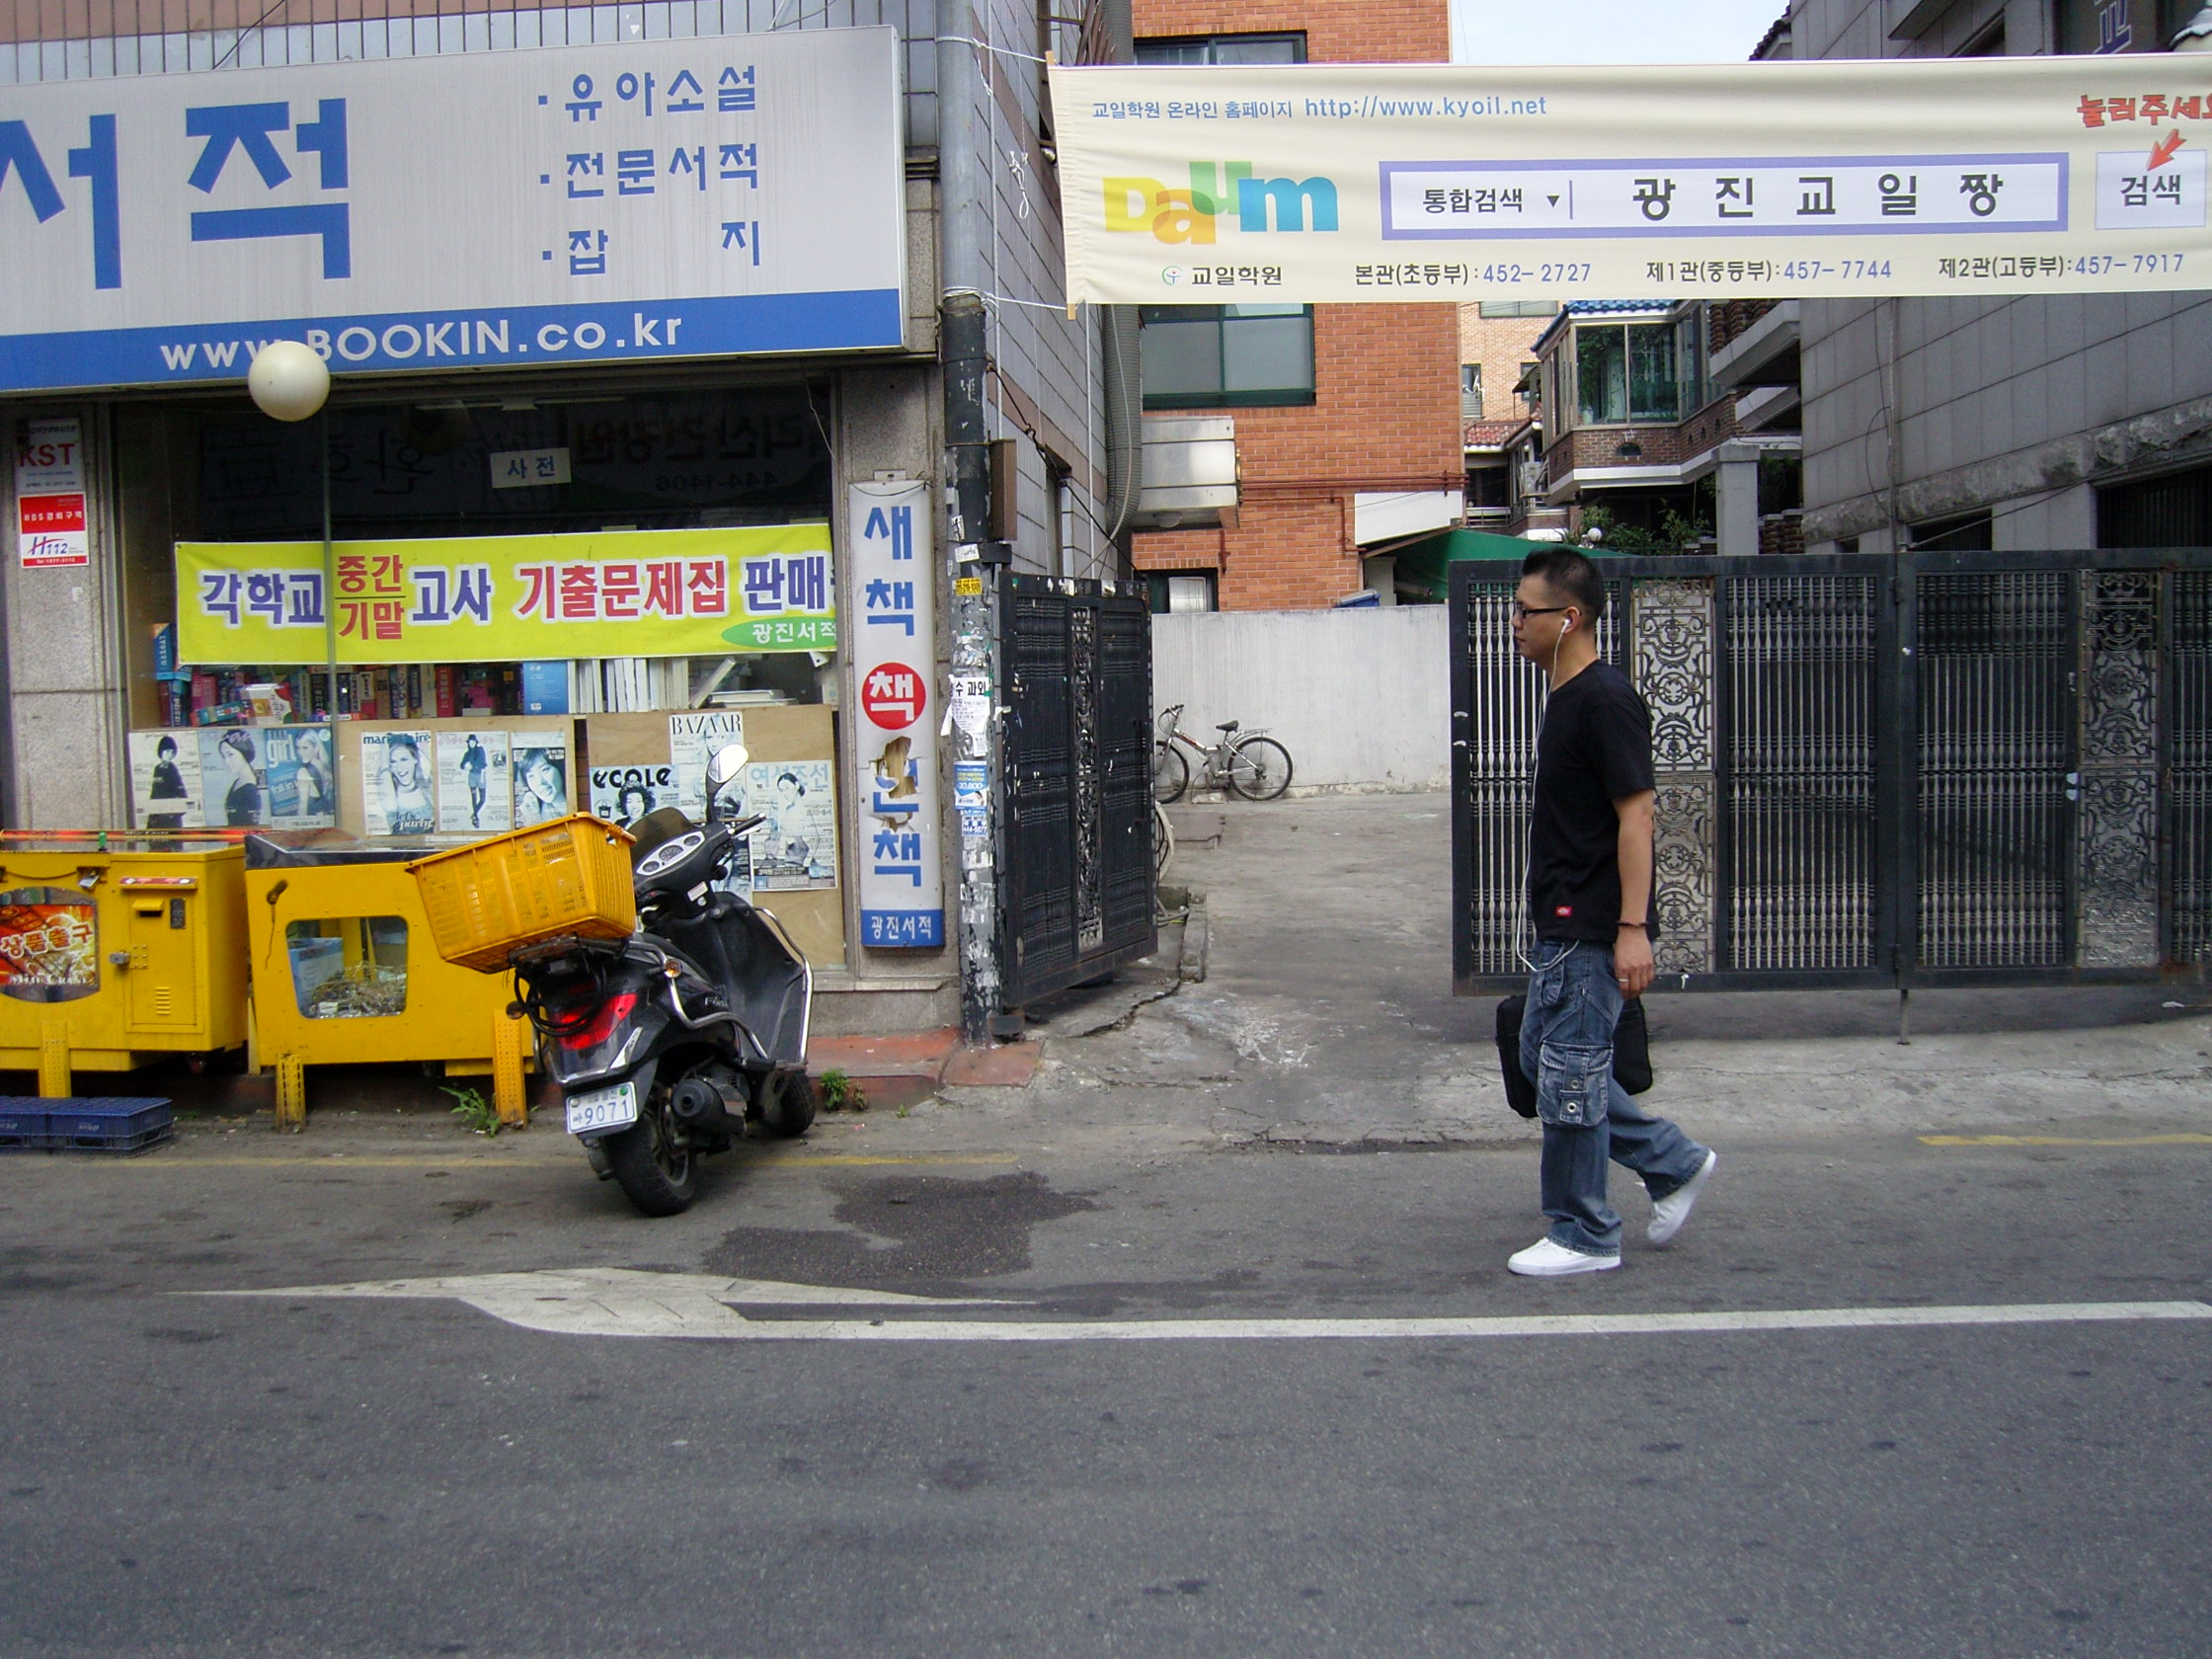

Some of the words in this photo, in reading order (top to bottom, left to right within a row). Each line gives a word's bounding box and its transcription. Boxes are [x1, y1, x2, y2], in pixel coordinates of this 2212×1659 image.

[565, 65, 755, 121] 유아소설
[1092, 102, 1160, 118] 교일학원
[1167, 101, 1218, 118] 온라인
[1224, 101, 1293, 118] 홈페이지
[1304, 96, 1547, 118] http://www.kyoil.net
[566, 143, 757, 198] 전문서적
[1103, 161, 1339, 244] Daum
[1422, 188, 1523, 213] 통합검색
[2120, 174, 2181, 206] 검색
[1191, 266, 1282, 285] 교일학원
[160, 313, 681, 370] wwBOOKIN.co.kr
[20, 442, 76, 467] KST
[203, 574, 325, 624] 각학교
[337, 555, 403, 592] 중간
[413, 568, 492, 621] 고사
[518, 560, 725, 619] 기출문제집
[745, 556, 835, 610] 판매
[339, 601, 404, 640] 기말
[752, 622, 836, 643] 광진서적
[869, 672, 914, 721] 책
[672, 714, 742, 736] BAZAAR
[1, 922, 94, 958] 상품출구
[871, 915, 931, 940] 광진서적
[585, 1099, 628, 1125] 9071
